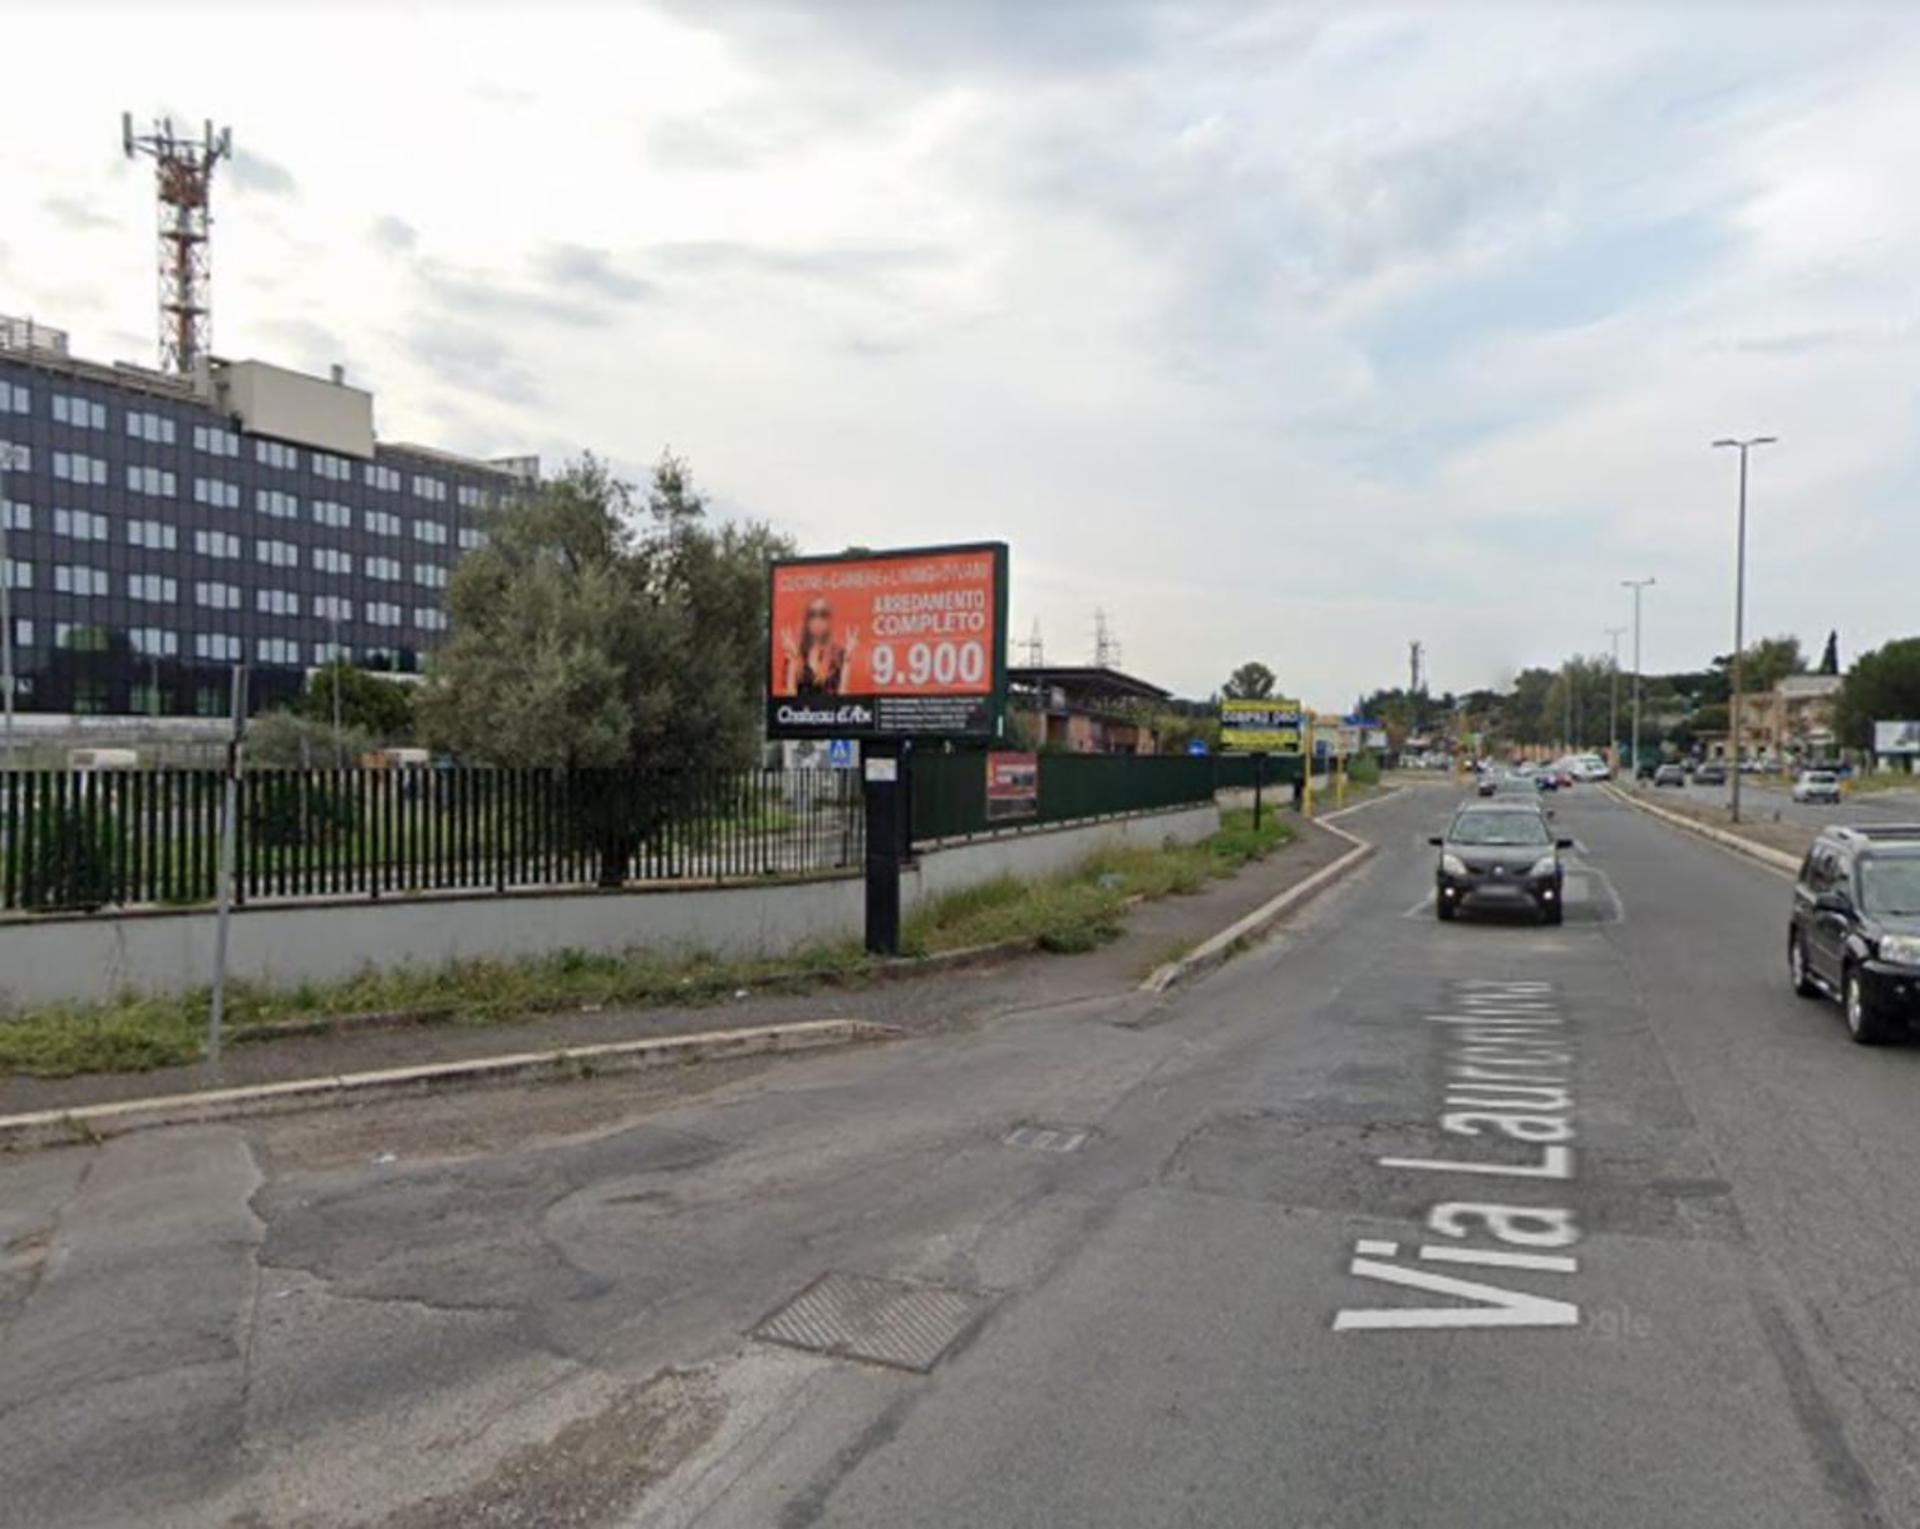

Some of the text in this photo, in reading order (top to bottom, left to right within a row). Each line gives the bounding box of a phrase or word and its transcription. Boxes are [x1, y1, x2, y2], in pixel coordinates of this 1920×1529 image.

[873, 590, 984, 613] ARREDAMENTO
[872, 611, 984, 635] COMPLETO
[872, 641, 984, 685] 9.900
